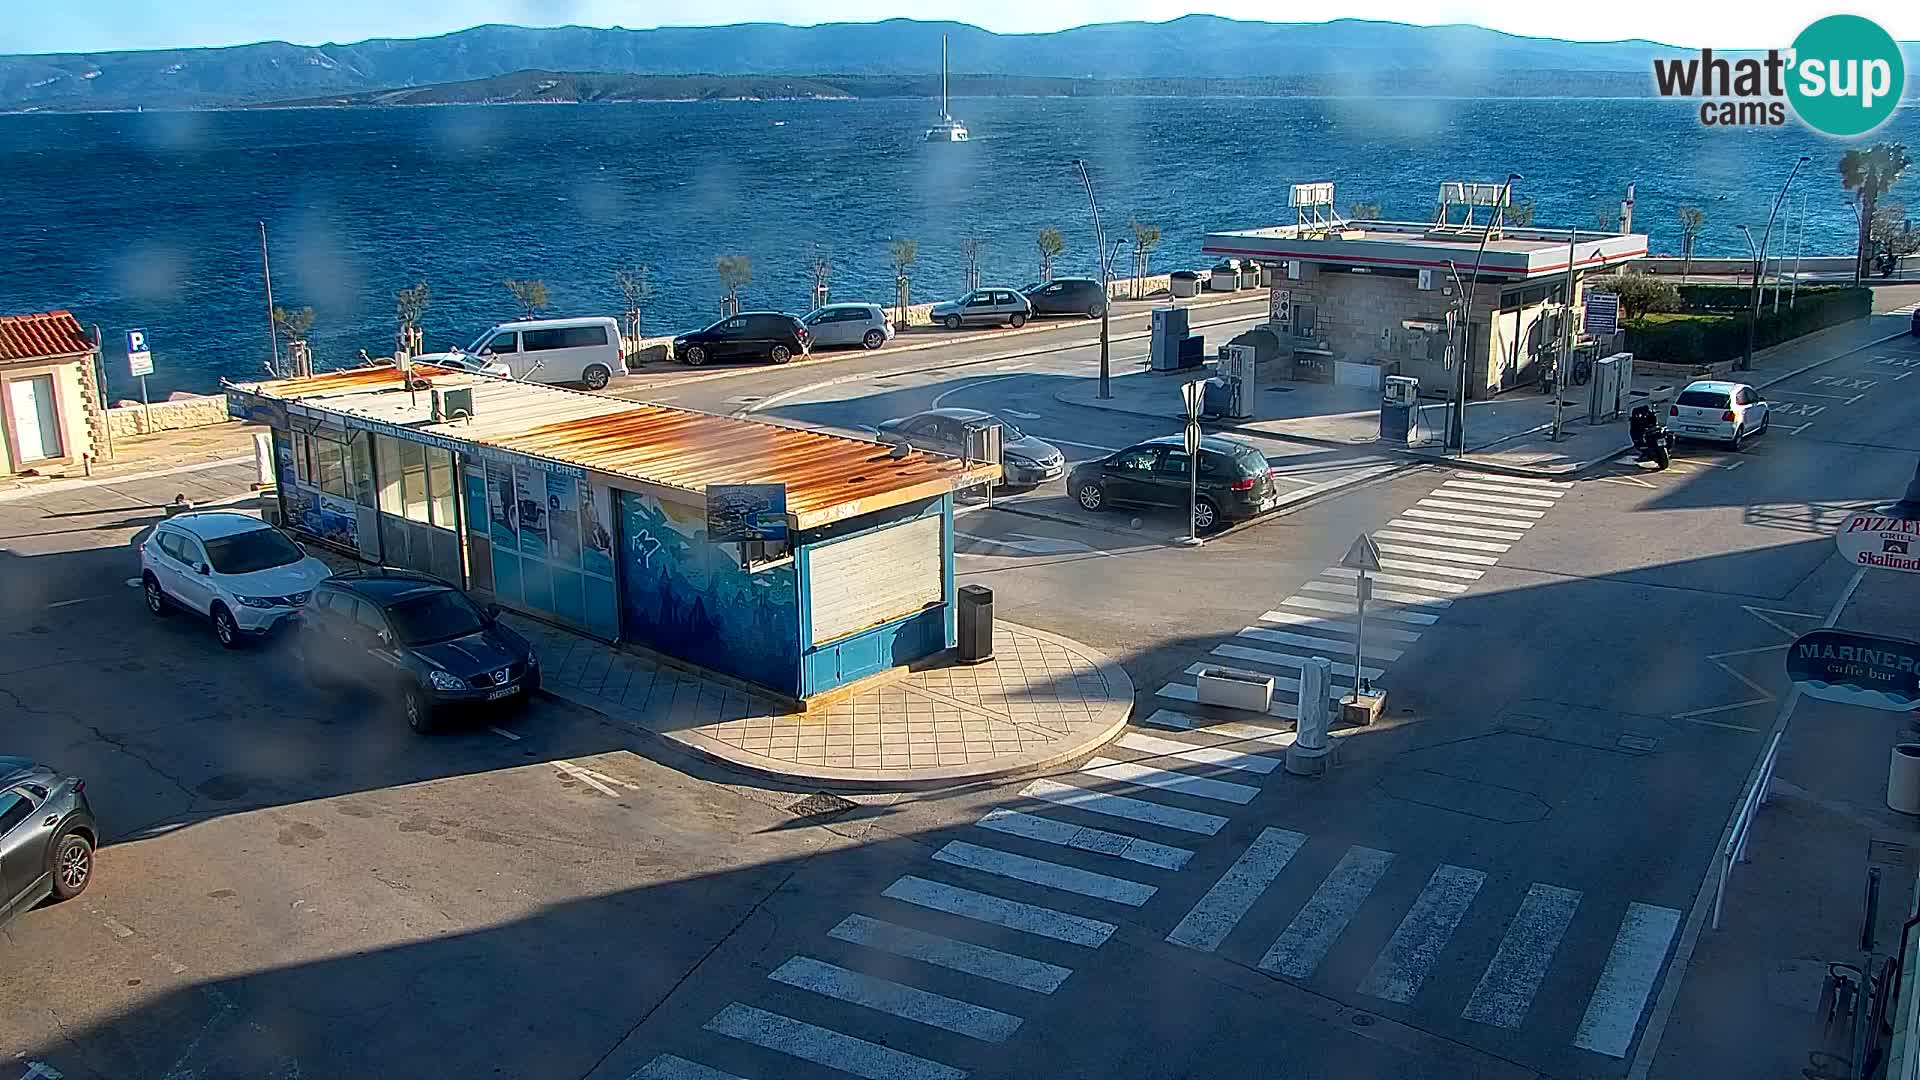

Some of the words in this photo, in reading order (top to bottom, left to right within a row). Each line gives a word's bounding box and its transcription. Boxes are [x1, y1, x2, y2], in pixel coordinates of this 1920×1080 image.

[1812, 376, 1878, 390] TAXI
[528, 458, 554, 472] TICKET
[555, 464, 583, 478] OFFICE
[1880, 532, 1914, 543] GRILL
[1868, 667, 1895, 681] bar
